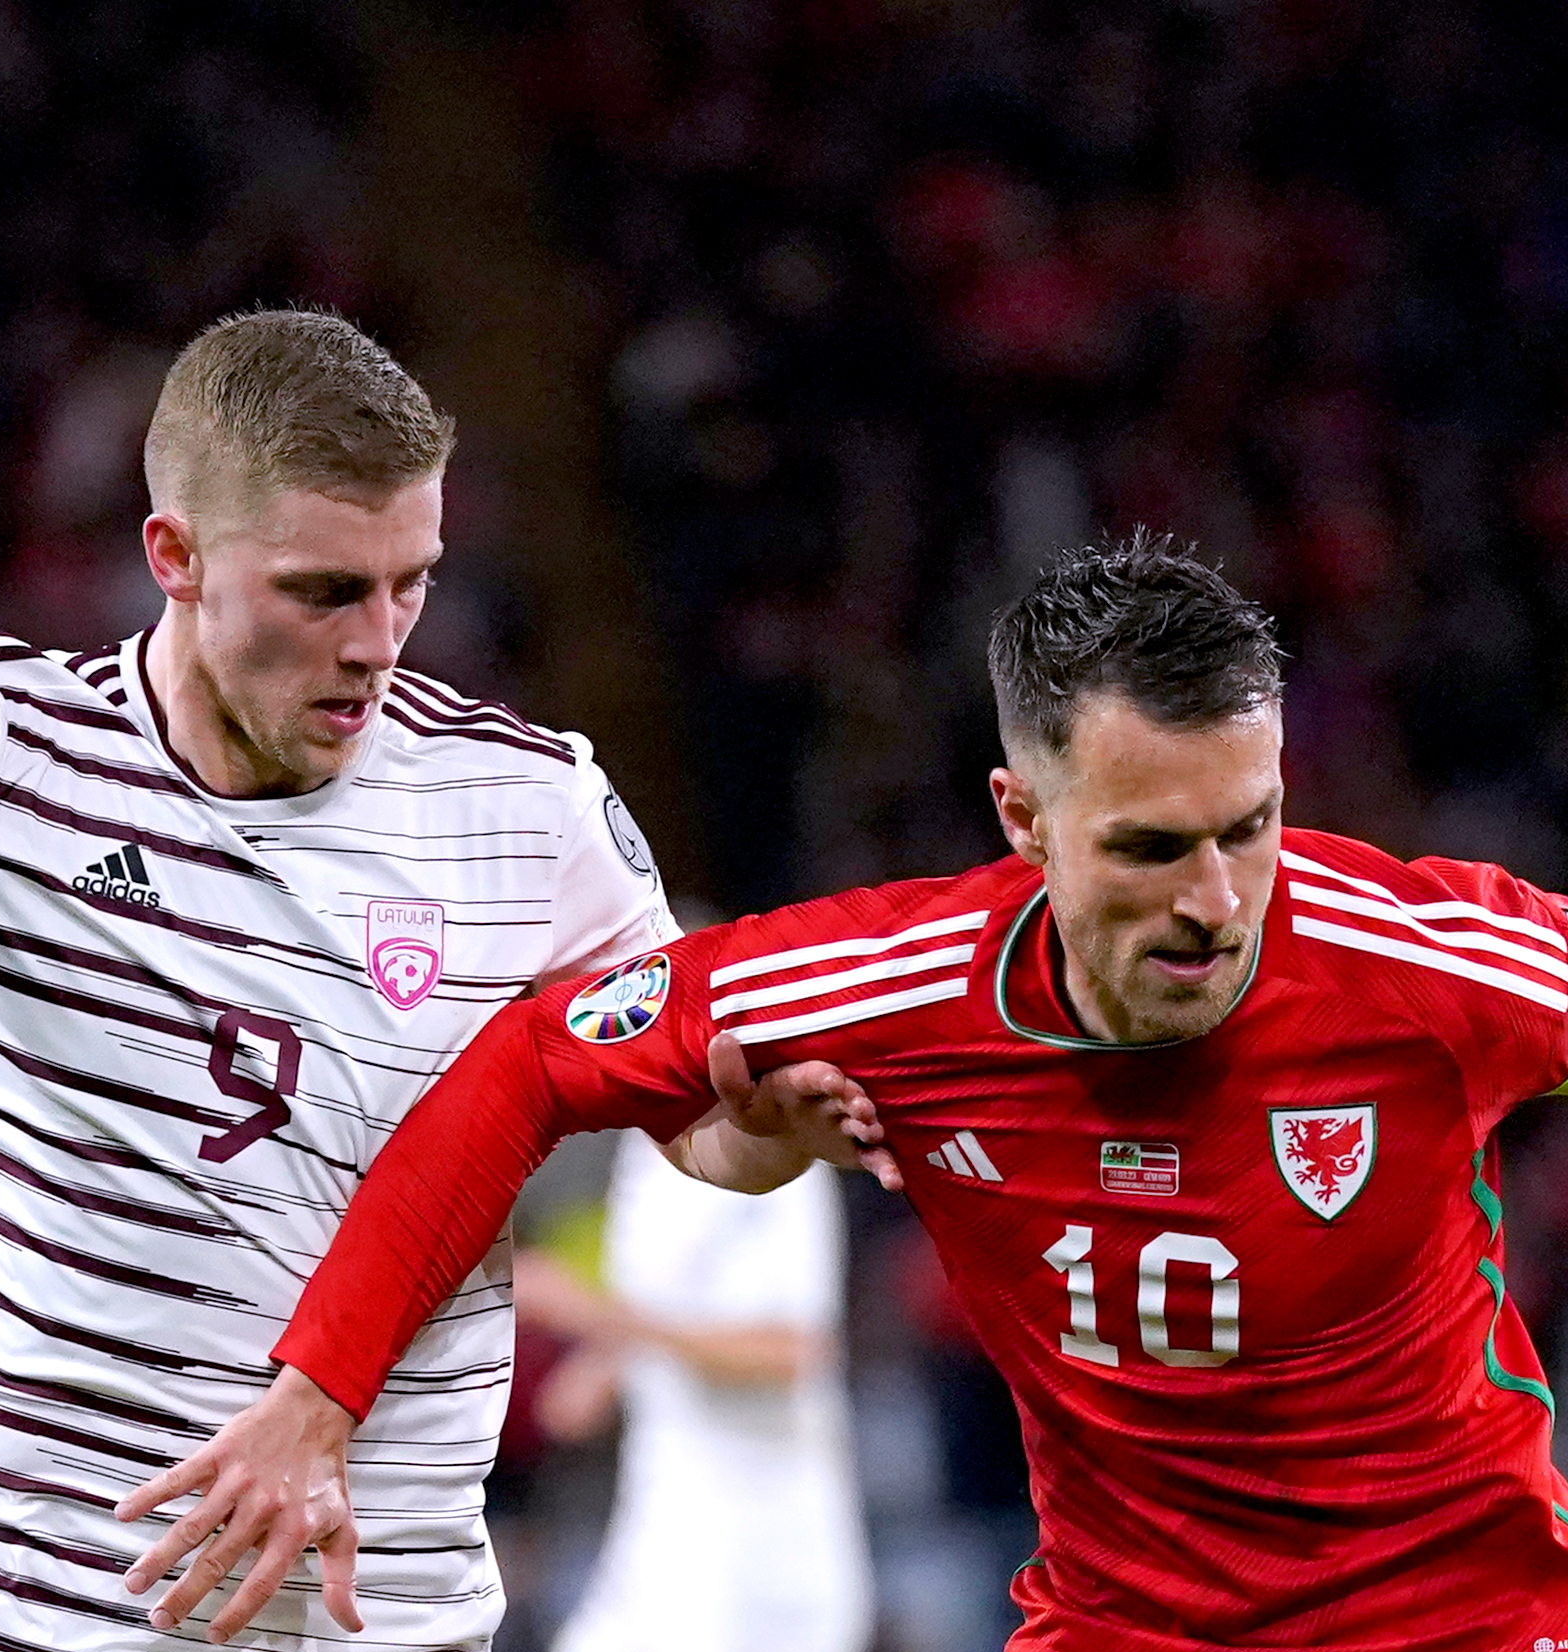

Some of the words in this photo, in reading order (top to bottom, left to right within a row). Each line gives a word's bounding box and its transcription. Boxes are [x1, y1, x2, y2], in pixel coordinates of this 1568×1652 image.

[72, 875, 160, 908] adidas
[377, 908, 435, 926] LATVIJA
[198, 1008, 303, 1164] 9
[1041, 1224, 1240, 1368] 10
